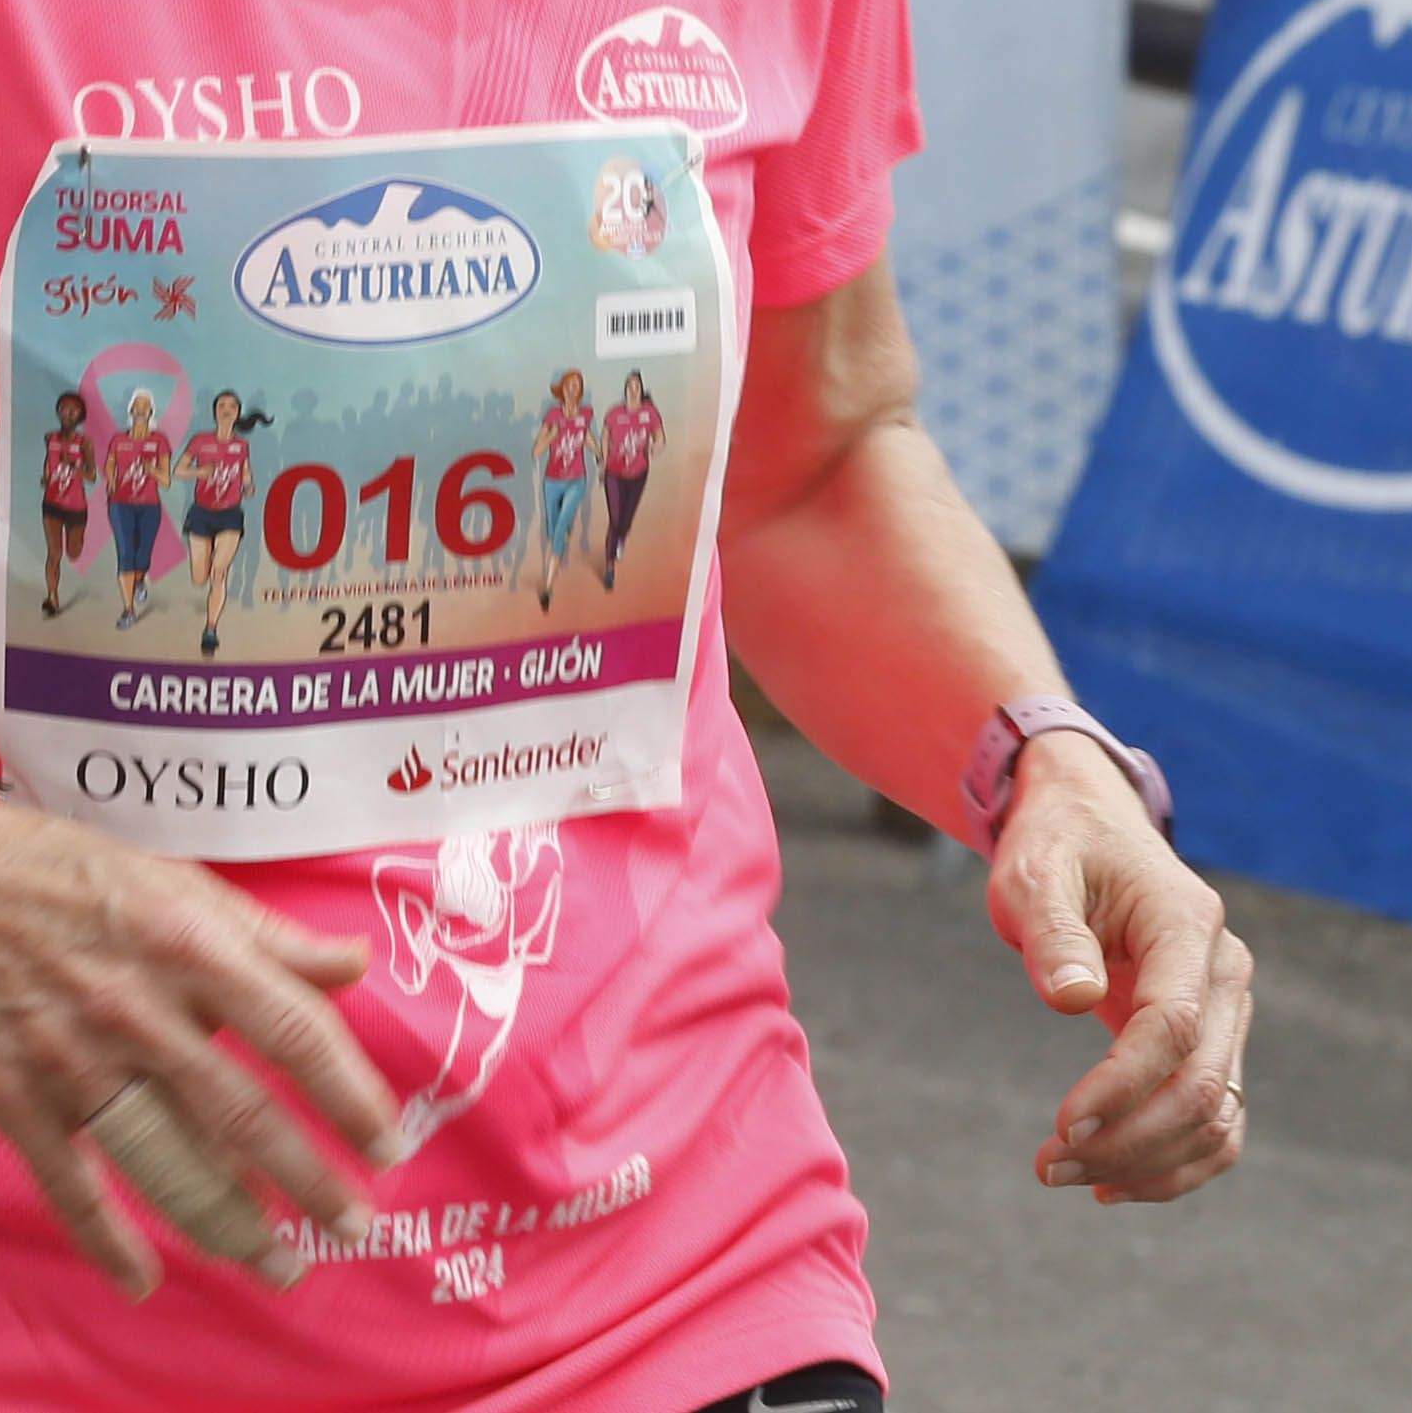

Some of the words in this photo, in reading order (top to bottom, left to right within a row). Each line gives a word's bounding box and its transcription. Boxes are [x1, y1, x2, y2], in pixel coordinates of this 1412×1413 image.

[72, 66, 362, 142] OYSHO
[597, 55, 740, 114] ASTURIANA
[55, 187, 85, 211] TU
[92, 188, 188, 215] DORSAL
[55, 212, 185, 256] SUMA
[314, 234, 406, 257] CENTRAL
[415, 227, 509, 253] LECHERA
[259, 243, 521, 309] ASTURIANA
[262, 448, 519, 572] 016
[319, 600, 431, 654] 2481
[109, 670, 279, 717] CARRERA
[291, 671, 332, 714] DE
[341, 667, 380, 709] LA
[391, 646, 495, 706] MUJER
[519, 633, 603, 690] GIJÓN
[76, 748, 310, 812] OYSHO
[440, 730, 608, 792] Santander
[440, 1202, 490, 1248] DE
[494, 1201, 540, 1237] LA
[431, 1243, 505, 1304] 2024
